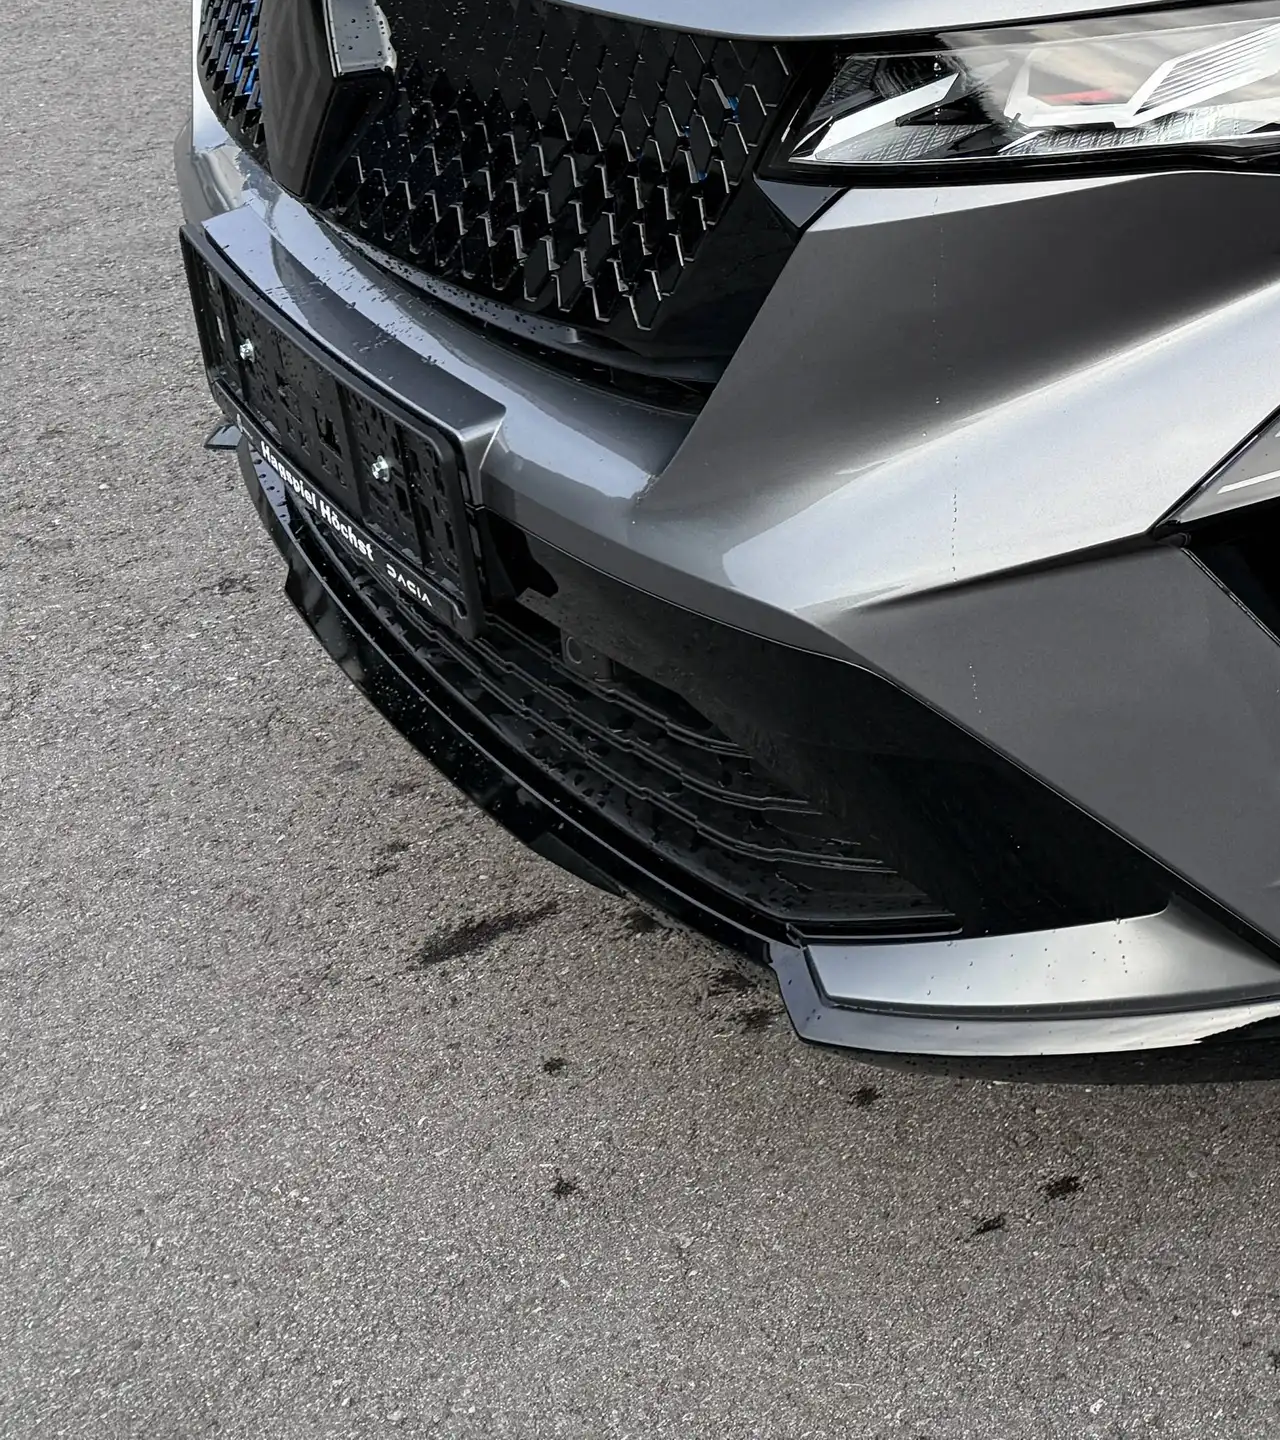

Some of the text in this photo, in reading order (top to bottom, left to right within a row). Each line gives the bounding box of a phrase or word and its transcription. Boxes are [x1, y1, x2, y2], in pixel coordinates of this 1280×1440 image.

[260, 440, 433, 607] Hagspiel Höchst DACIA
